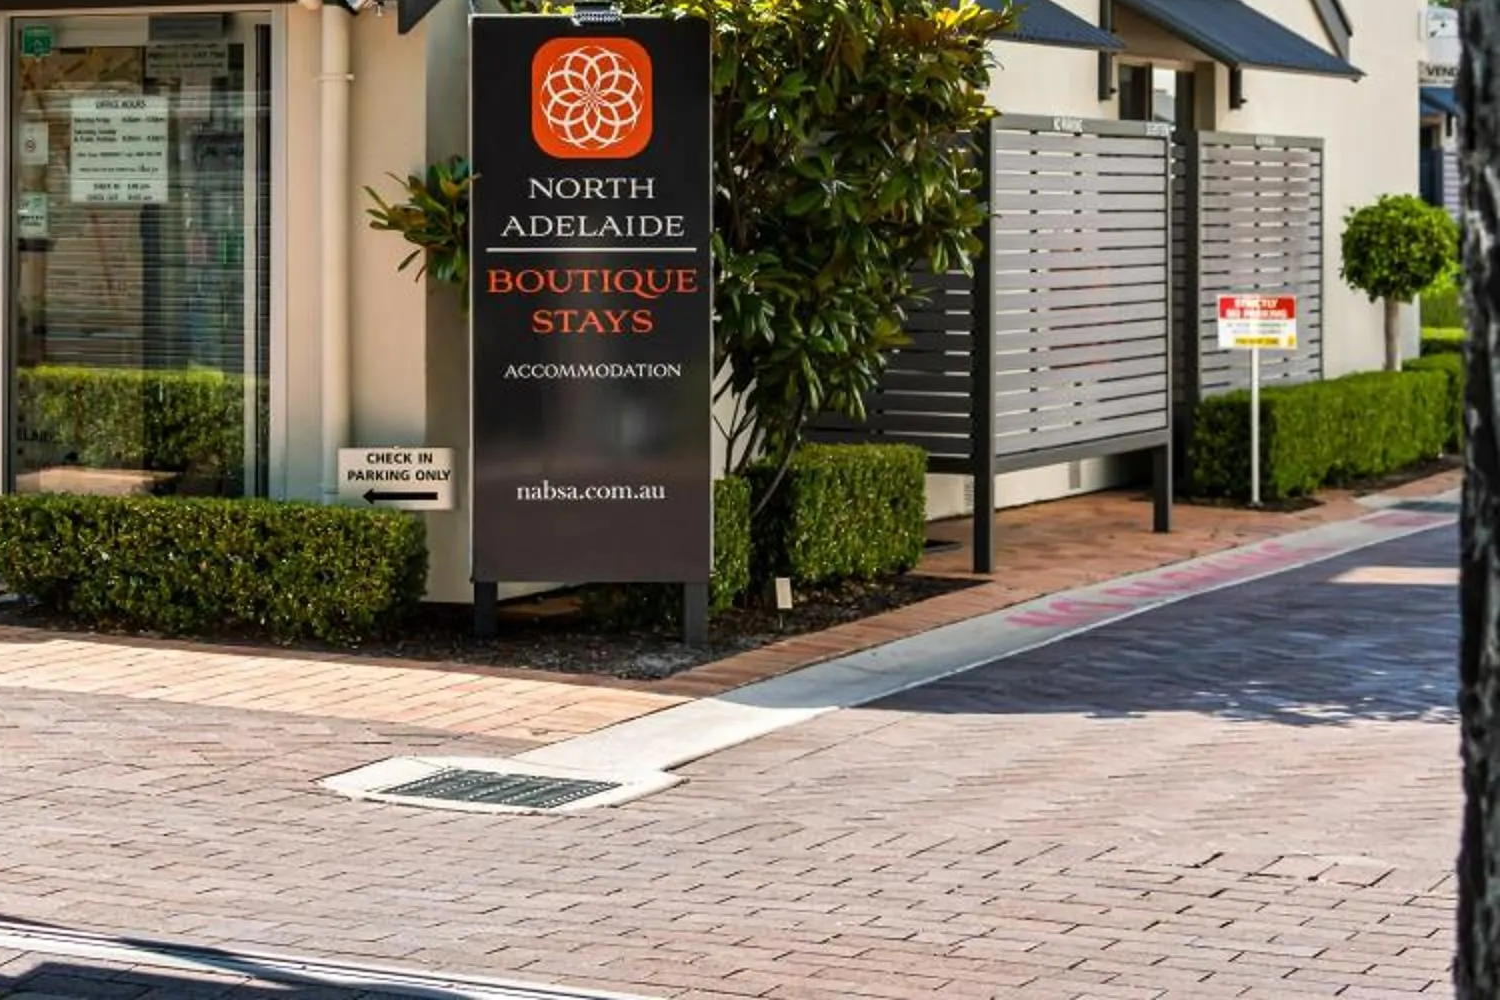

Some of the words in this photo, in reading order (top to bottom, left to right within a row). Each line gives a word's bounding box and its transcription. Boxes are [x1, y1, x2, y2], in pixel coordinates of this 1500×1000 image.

[528, 177, 656, 200] NORTH
[501, 214, 685, 238] ADELAIDE
[487, 268, 698, 298] BOUTIQUE
[532, 309, 655, 334] STAYS
[503, 363, 682, 378] ACCOMMODATION
[366, 453, 412, 464] CHECK
[418, 453, 433, 464] IN
[347, 469, 410, 481] PARKING
[415, 469, 451, 481] ONLY
[516, 480, 666, 500] nabsa.com.au
